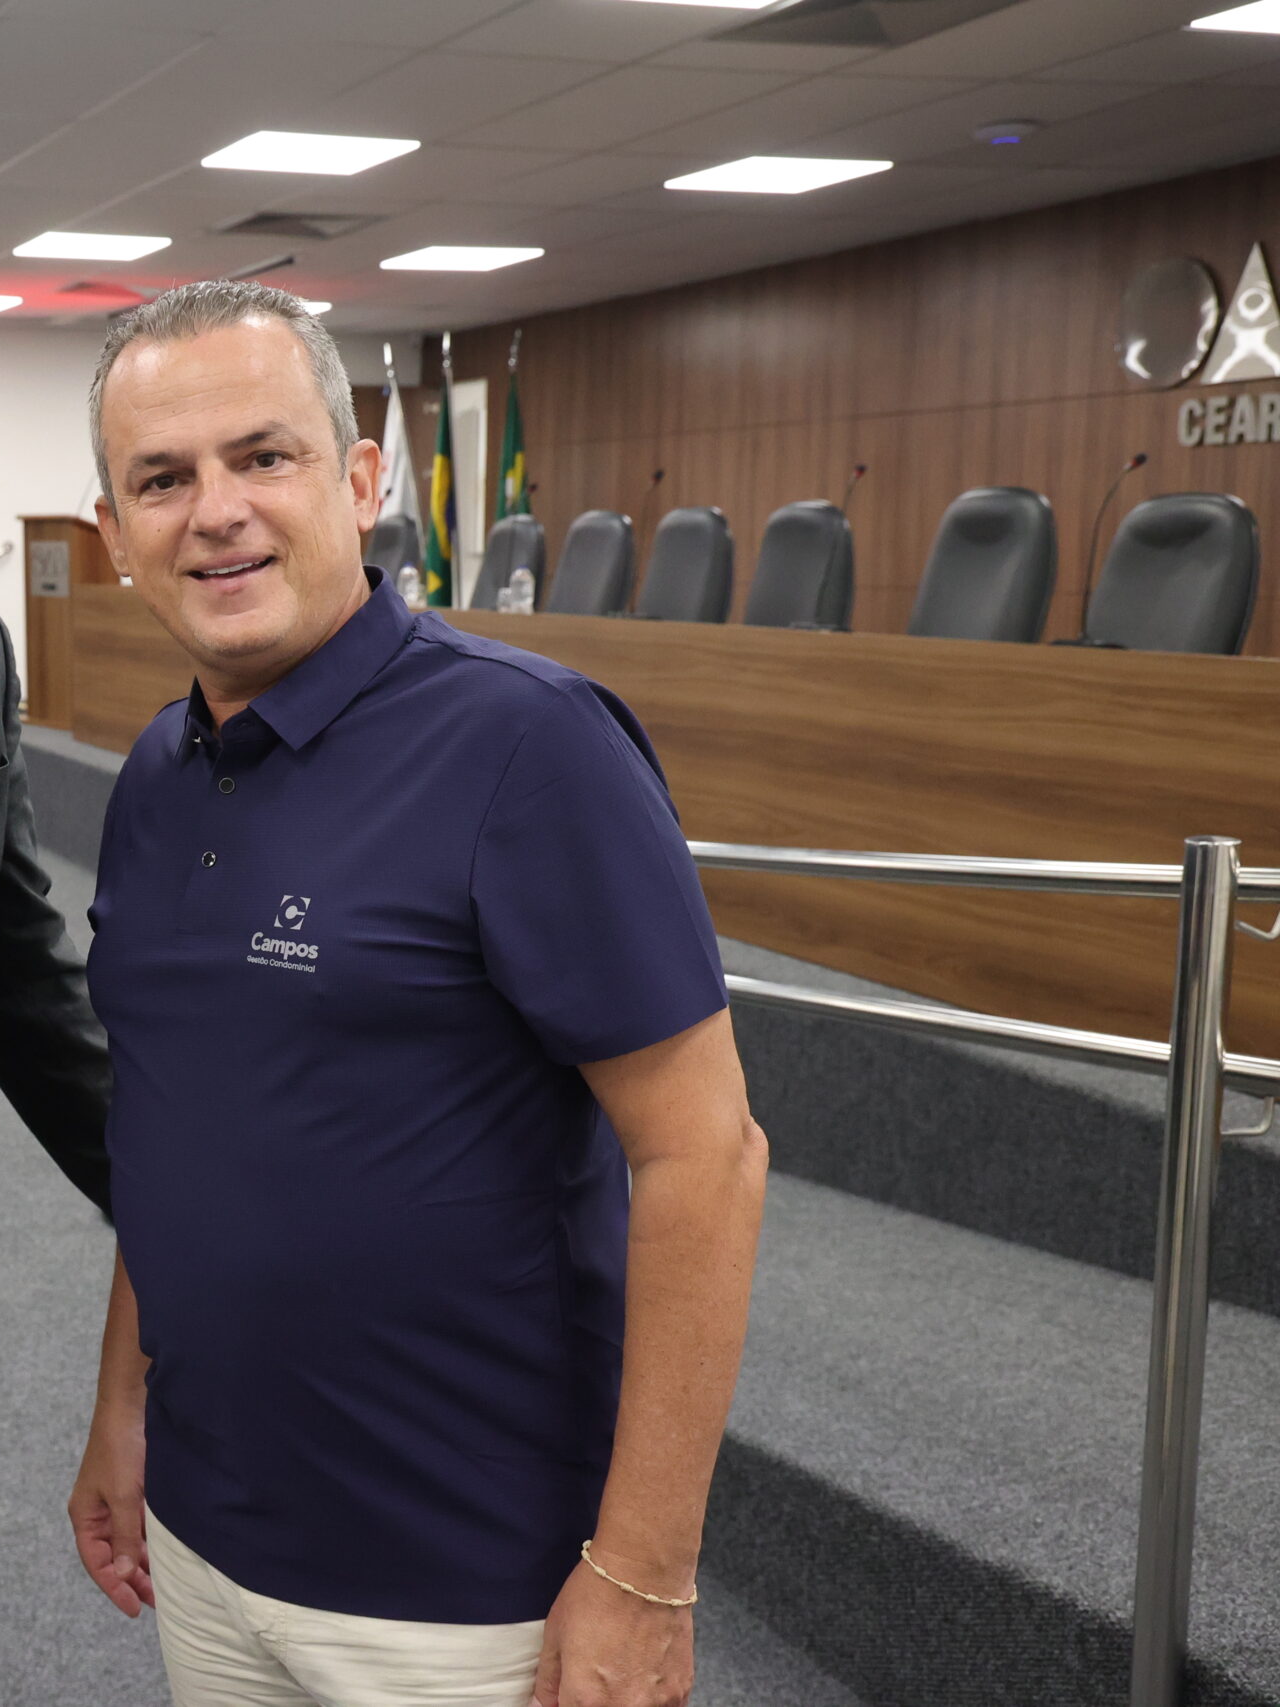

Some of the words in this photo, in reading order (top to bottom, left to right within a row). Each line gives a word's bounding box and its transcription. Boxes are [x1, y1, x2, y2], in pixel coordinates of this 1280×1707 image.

[1178, 393, 1280, 446] CEAR
[251, 931, 319, 960] Campos
[270, 959, 315, 972] Condominial
